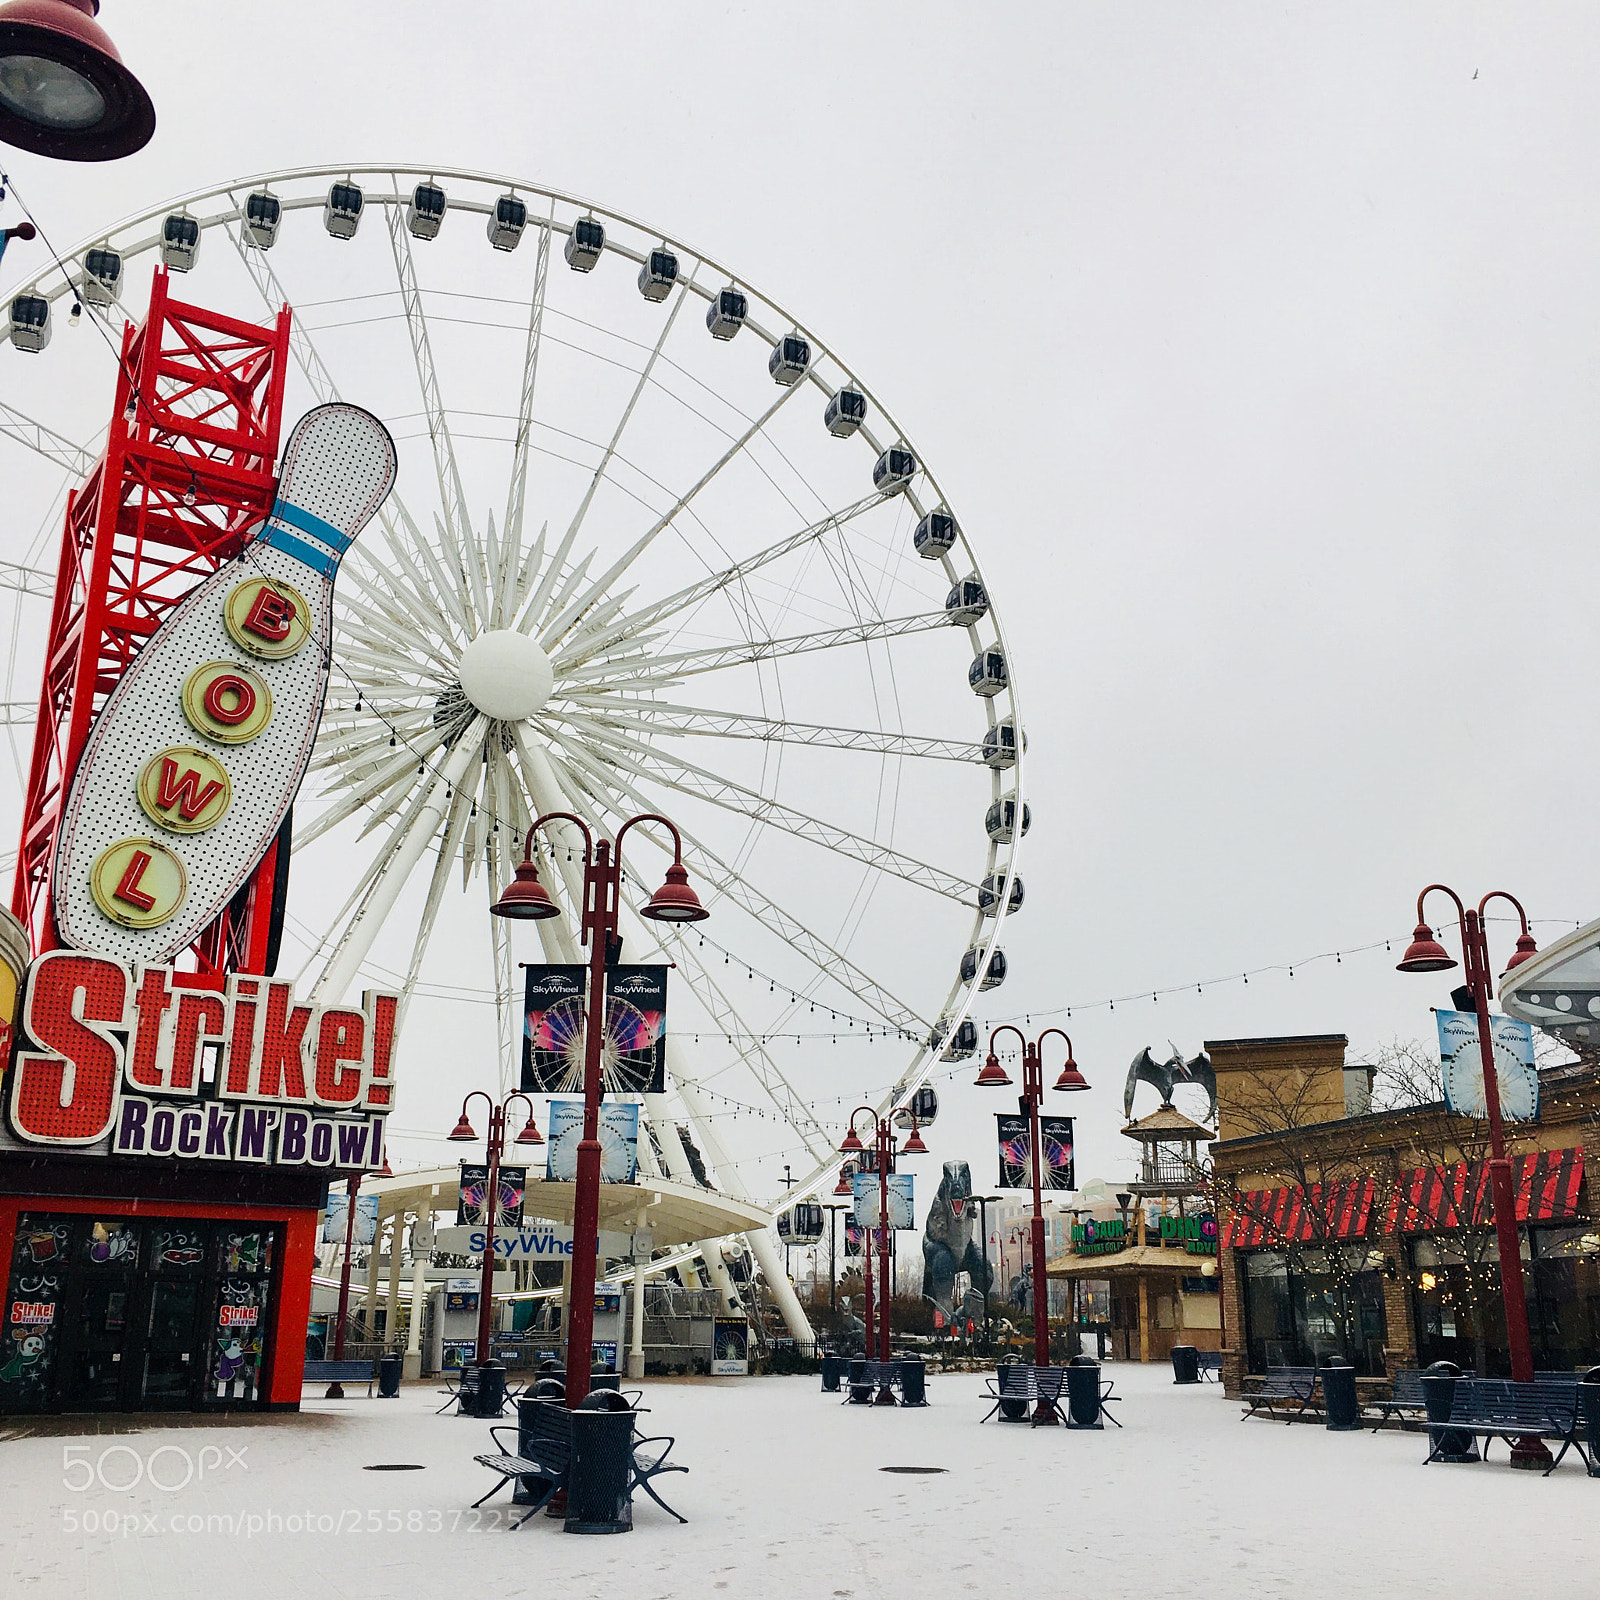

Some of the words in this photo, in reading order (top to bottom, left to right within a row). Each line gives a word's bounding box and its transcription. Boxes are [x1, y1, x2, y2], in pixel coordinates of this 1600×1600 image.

[113, 585, 297, 912] BOWL
[532, 985, 579, 995] SkyWheel
[613, 985, 660, 995] SkyWheel
[1443, 1027, 1475, 1036] SkyWheel
[1498, 1034, 1529, 1043] SkyWheel
[12, 951, 398, 1143] Strike!
[115, 1096, 234, 1159] Rock
[1071, 1219, 1124, 1242] DINOSAUR
[469, 1232, 600, 1257] SkyWhel
[11, 1301, 55, 1323] Strike!
[219, 1305, 259, 1326] Strike!
